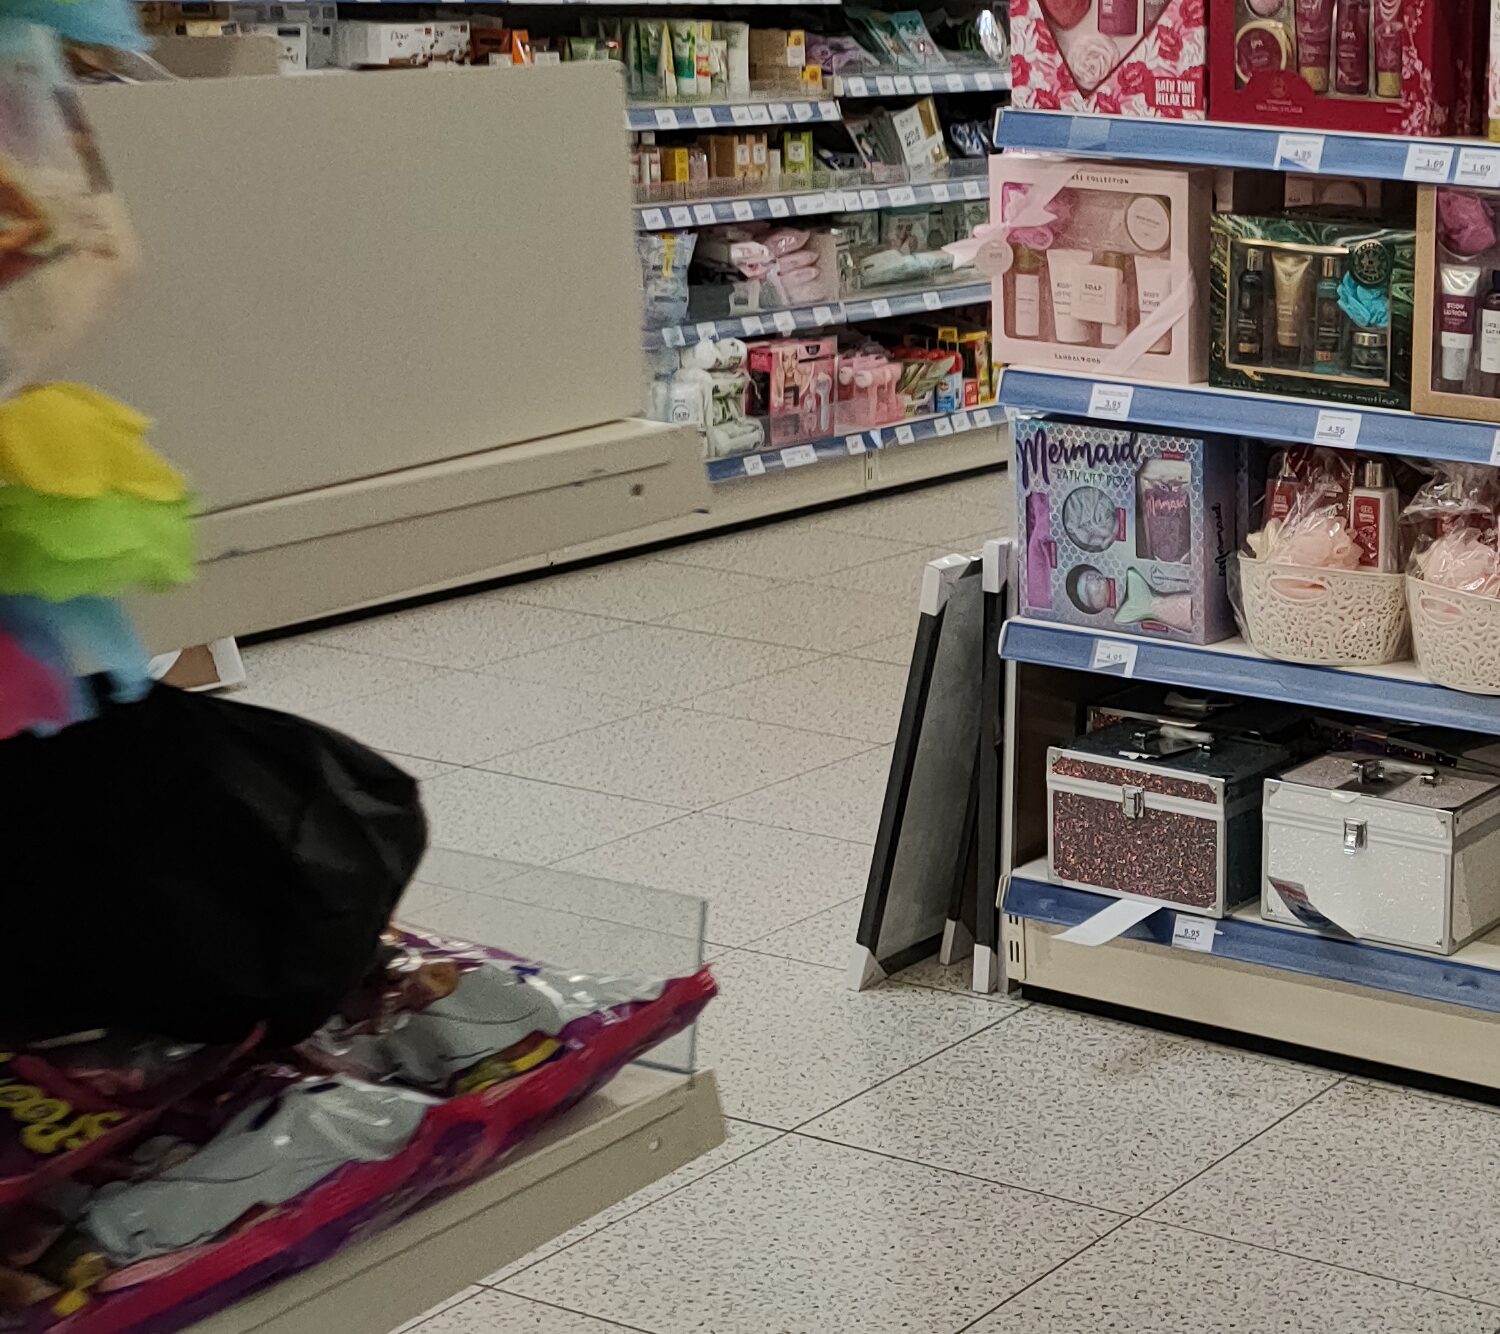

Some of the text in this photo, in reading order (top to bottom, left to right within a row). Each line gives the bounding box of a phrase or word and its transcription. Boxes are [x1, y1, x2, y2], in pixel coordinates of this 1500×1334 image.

[1178, 80, 1196, 96] TIME
[1086, 175, 1130, 185] COLLECTION
[1084, 283, 1103, 292] SOAP
[1016, 428, 1142, 490] Mermaid
[1106, 653, 1123, 662] 4.95
